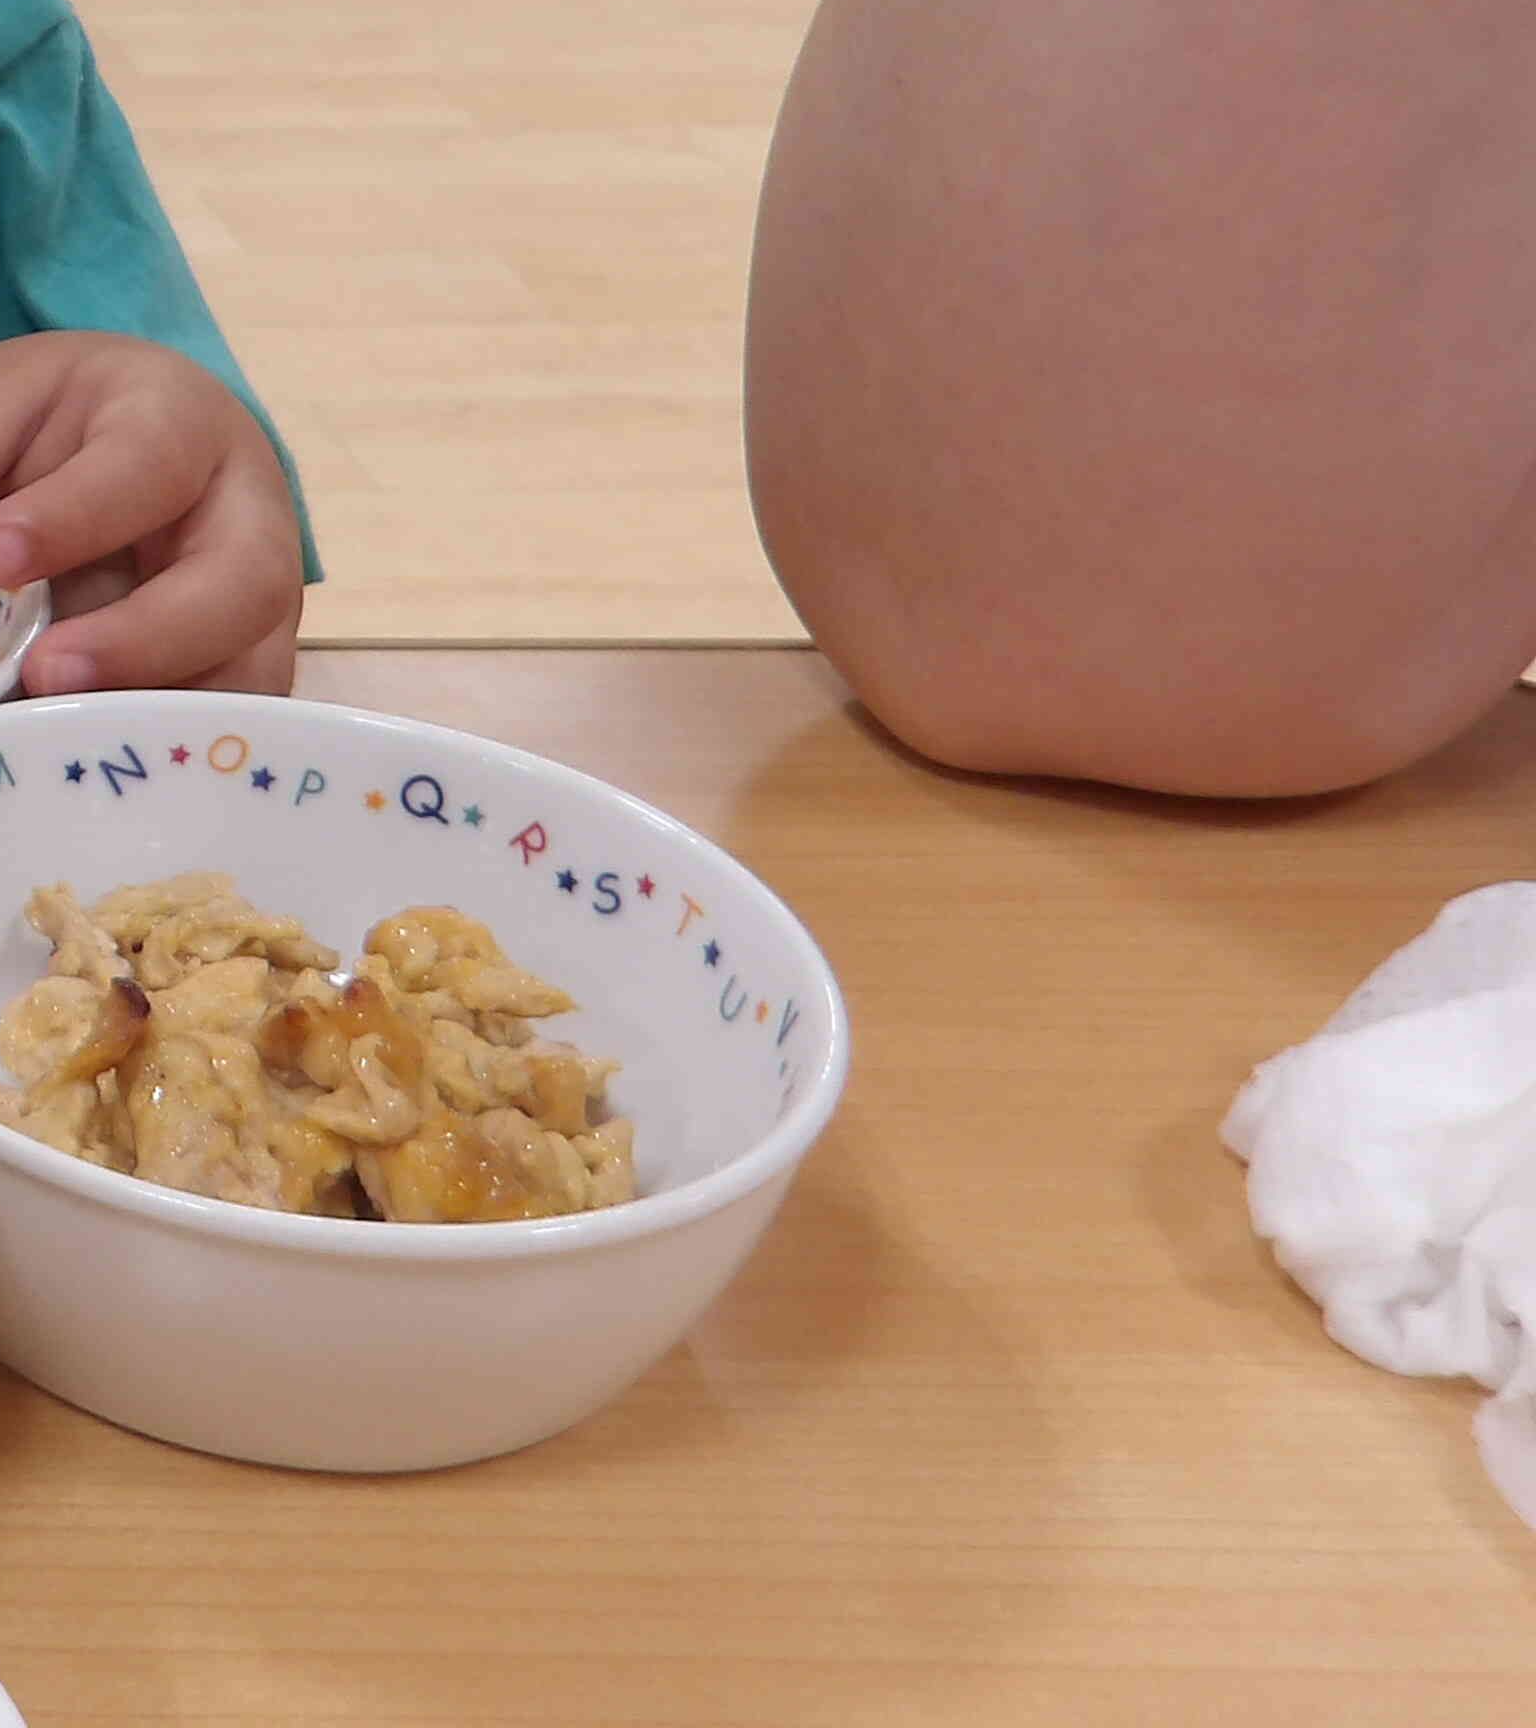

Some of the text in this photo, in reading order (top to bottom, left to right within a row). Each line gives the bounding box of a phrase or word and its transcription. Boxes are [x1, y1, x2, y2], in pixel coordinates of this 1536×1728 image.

[99, 744, 148, 797] N
[209, 734, 248, 773] O
[294, 769, 326, 806] P
[400, 775, 449, 825] Q
[509, 821, 547, 866] R
[593, 872, 621, 915] S
[678, 893, 705, 936] T
[719, 974, 747, 1023] U
[777, 1000, 800, 1048] V
